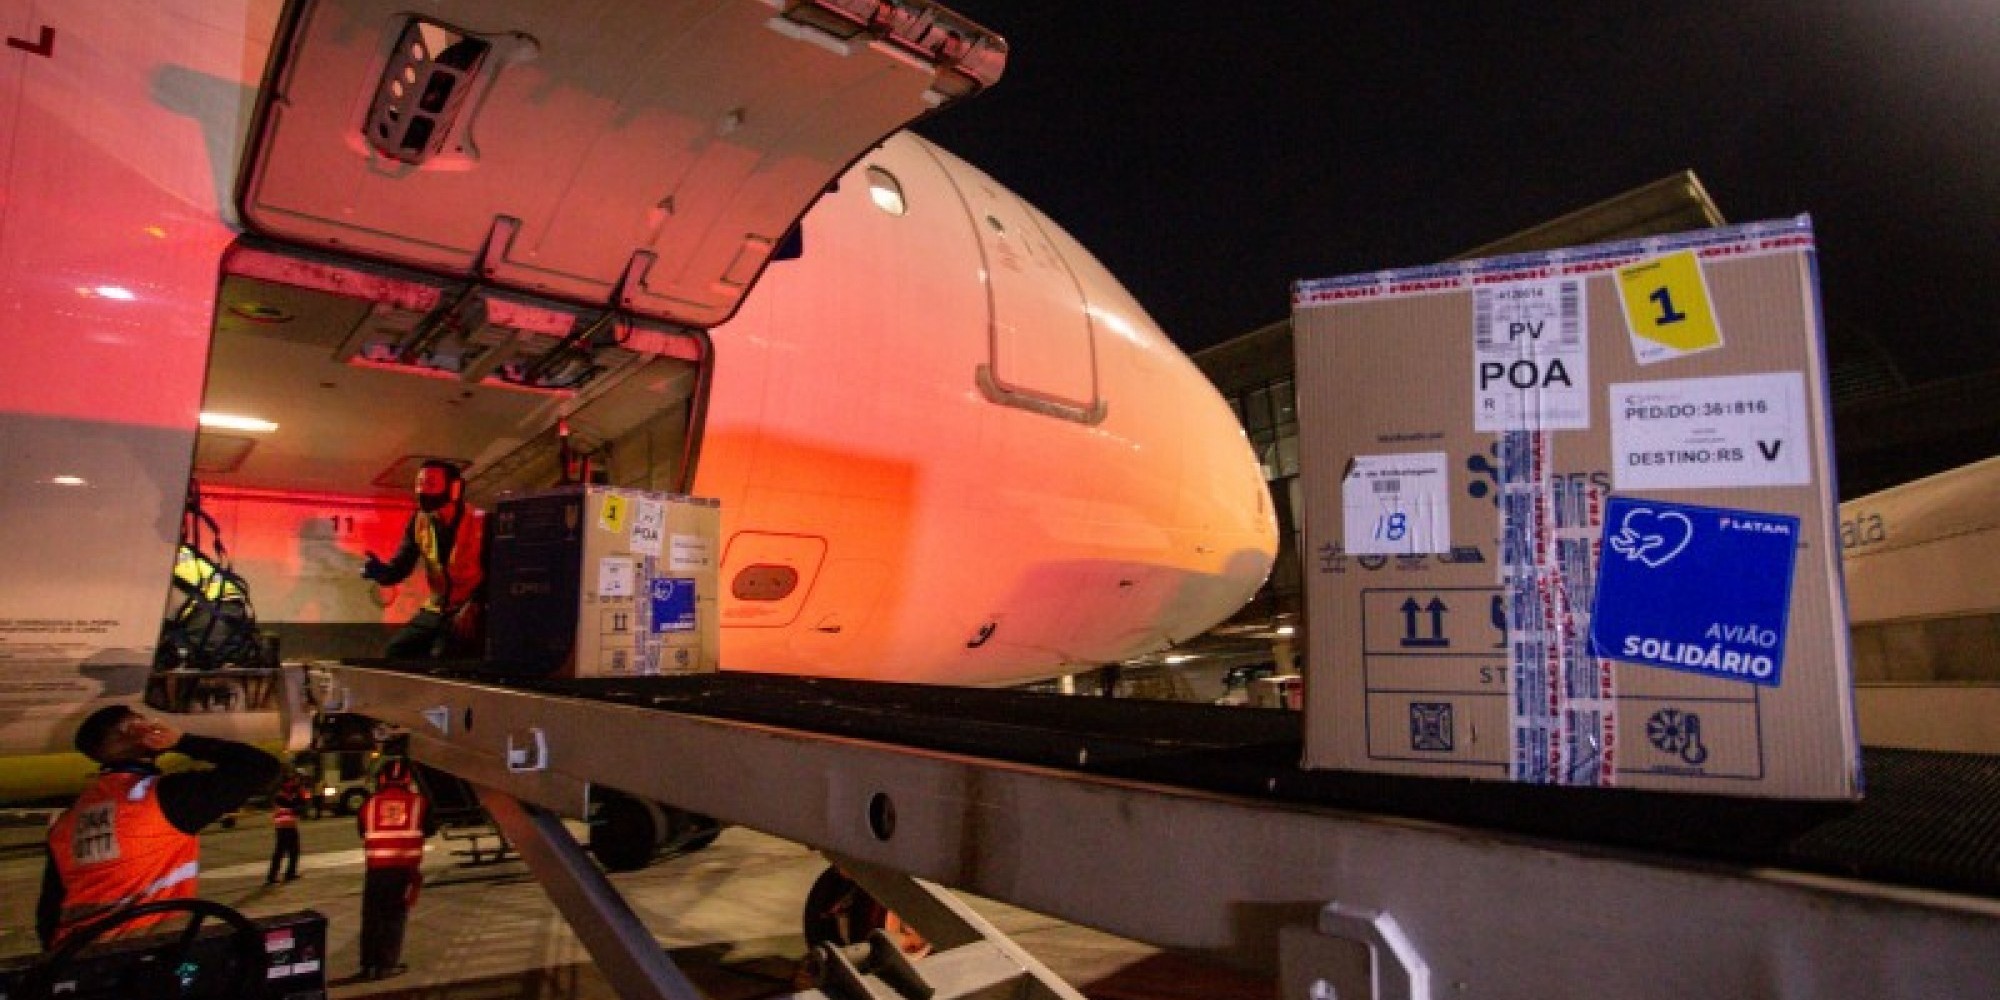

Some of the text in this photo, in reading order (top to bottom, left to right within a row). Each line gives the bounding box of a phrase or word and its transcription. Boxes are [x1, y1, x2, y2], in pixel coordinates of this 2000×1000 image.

[1650, 286, 1686, 325] 1
[1509, 320, 1544, 341] PV
[1479, 358, 1573, 391] POA
[1629, 439, 1783, 466] DESTINO:RS V
[330, 515, 354, 533] 11
[1374, 512, 1405, 541] 18
[1732, 519, 1790, 534] LATAM
[1705, 622, 1777, 649] AVIÃO
[1623, 635, 1773, 678] SOLIDÁRIO
